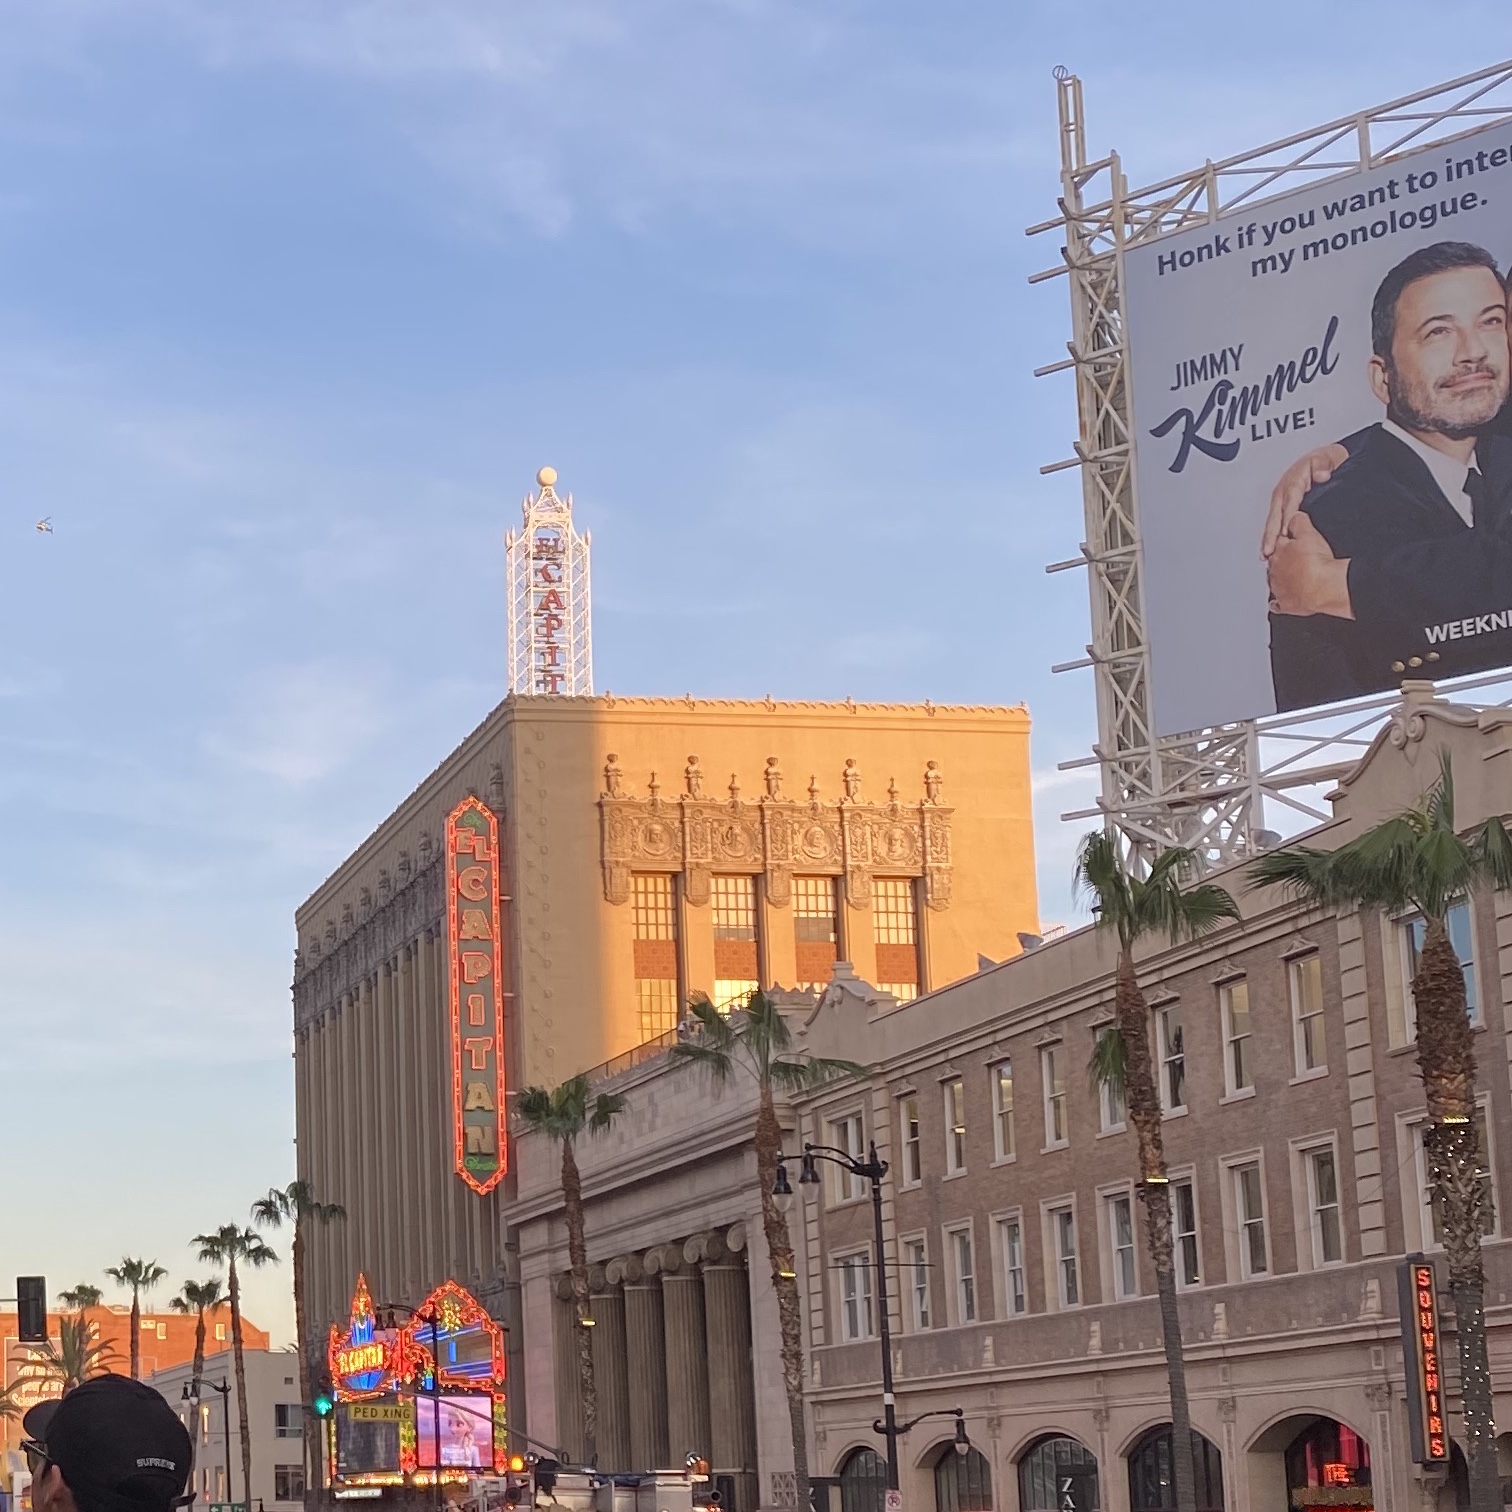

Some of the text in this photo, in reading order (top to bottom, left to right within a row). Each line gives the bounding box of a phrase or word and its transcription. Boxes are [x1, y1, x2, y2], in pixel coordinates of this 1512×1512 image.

[1157, 145, 1512, 276] Honk if you want to inte
[1250, 190, 1488, 278] my monologue.
[1149, 315, 1340, 473] Kimmel
[1170, 343, 1245, 391] JIMMY
[1251, 407, 1316, 442] LIVE!
[456, 827, 492, 863] EL
[457, 866, 495, 1156] CAPITAN
[1416, 1268, 1446, 1458] SOUVENIRS
[353, 1406, 411, 1419] PED XING
